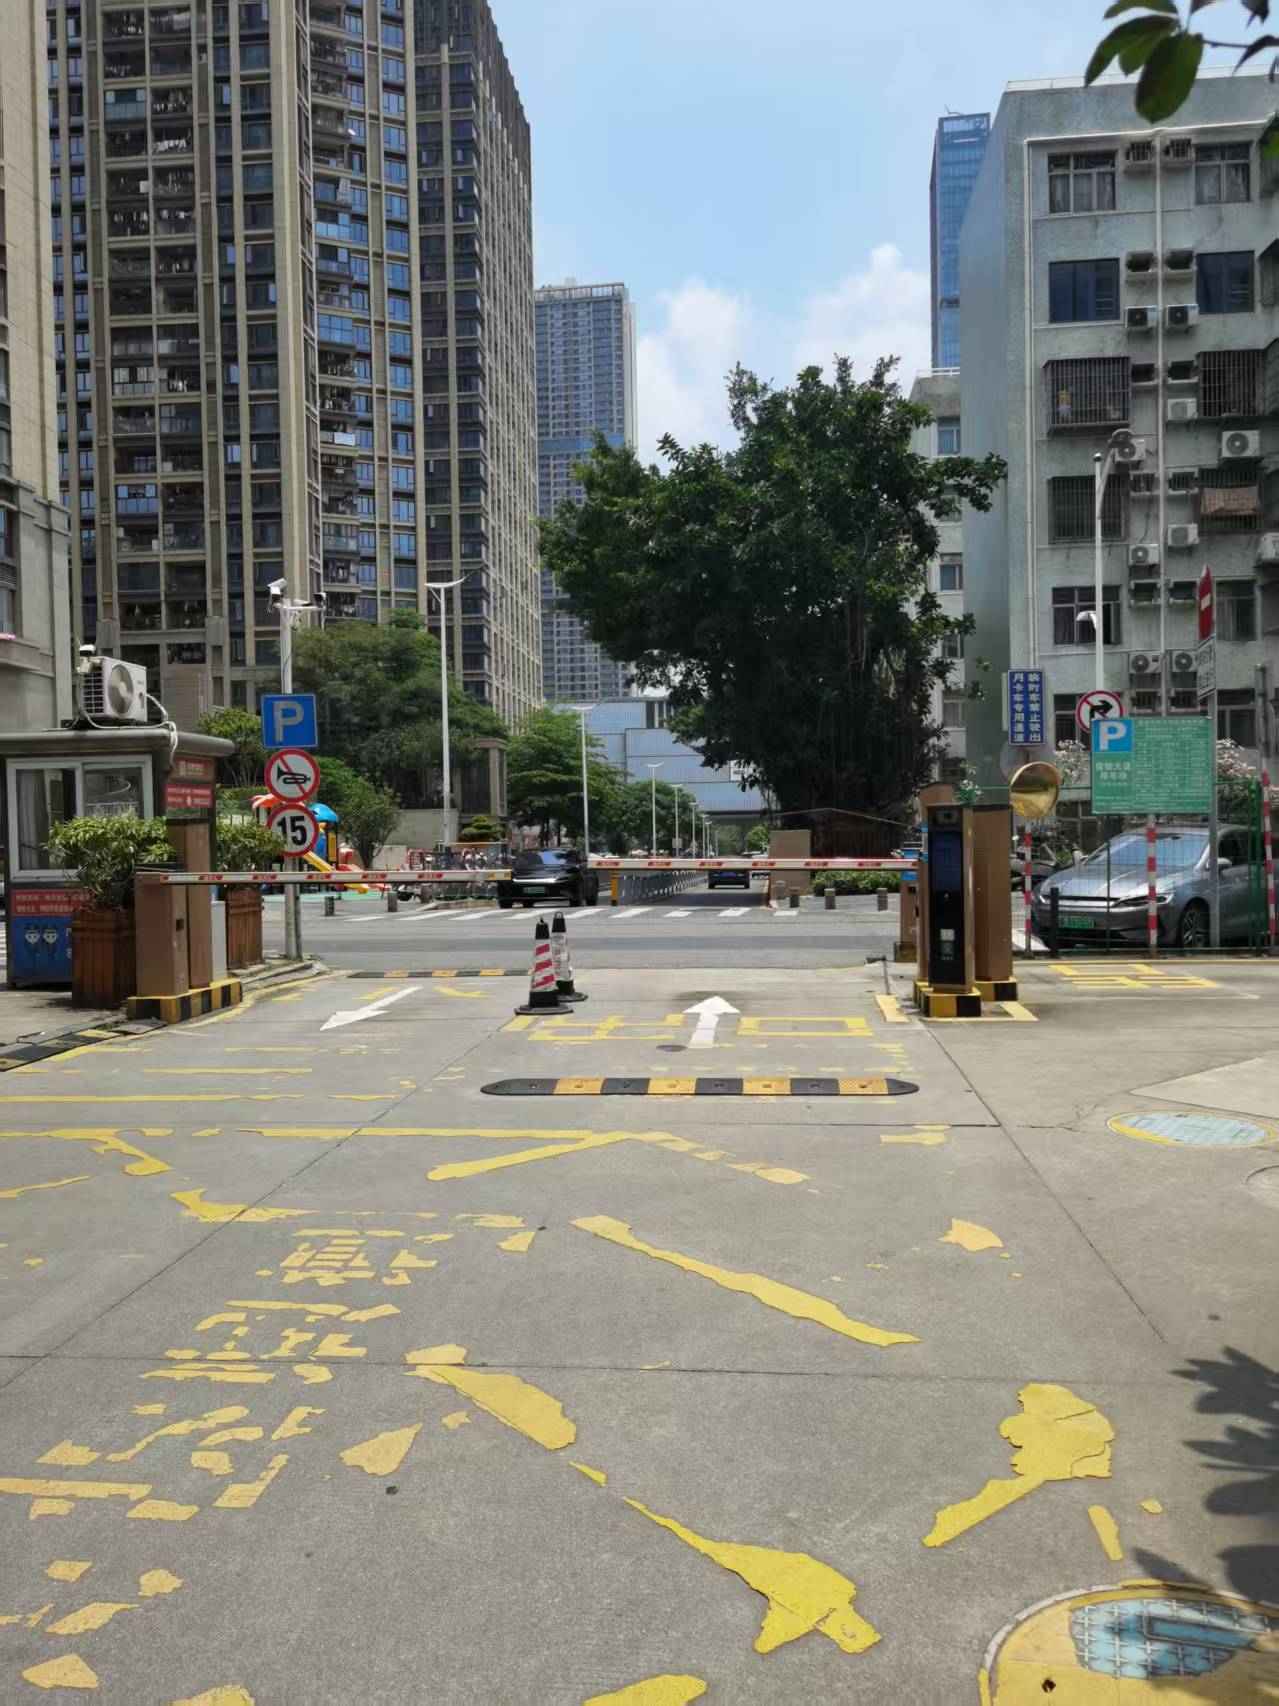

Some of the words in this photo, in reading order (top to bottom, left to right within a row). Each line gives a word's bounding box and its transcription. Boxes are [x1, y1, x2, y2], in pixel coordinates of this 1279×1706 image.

[273, 700, 304, 744] P
[1099, 720, 1127, 751] P
[277, 815, 307, 846] 15
